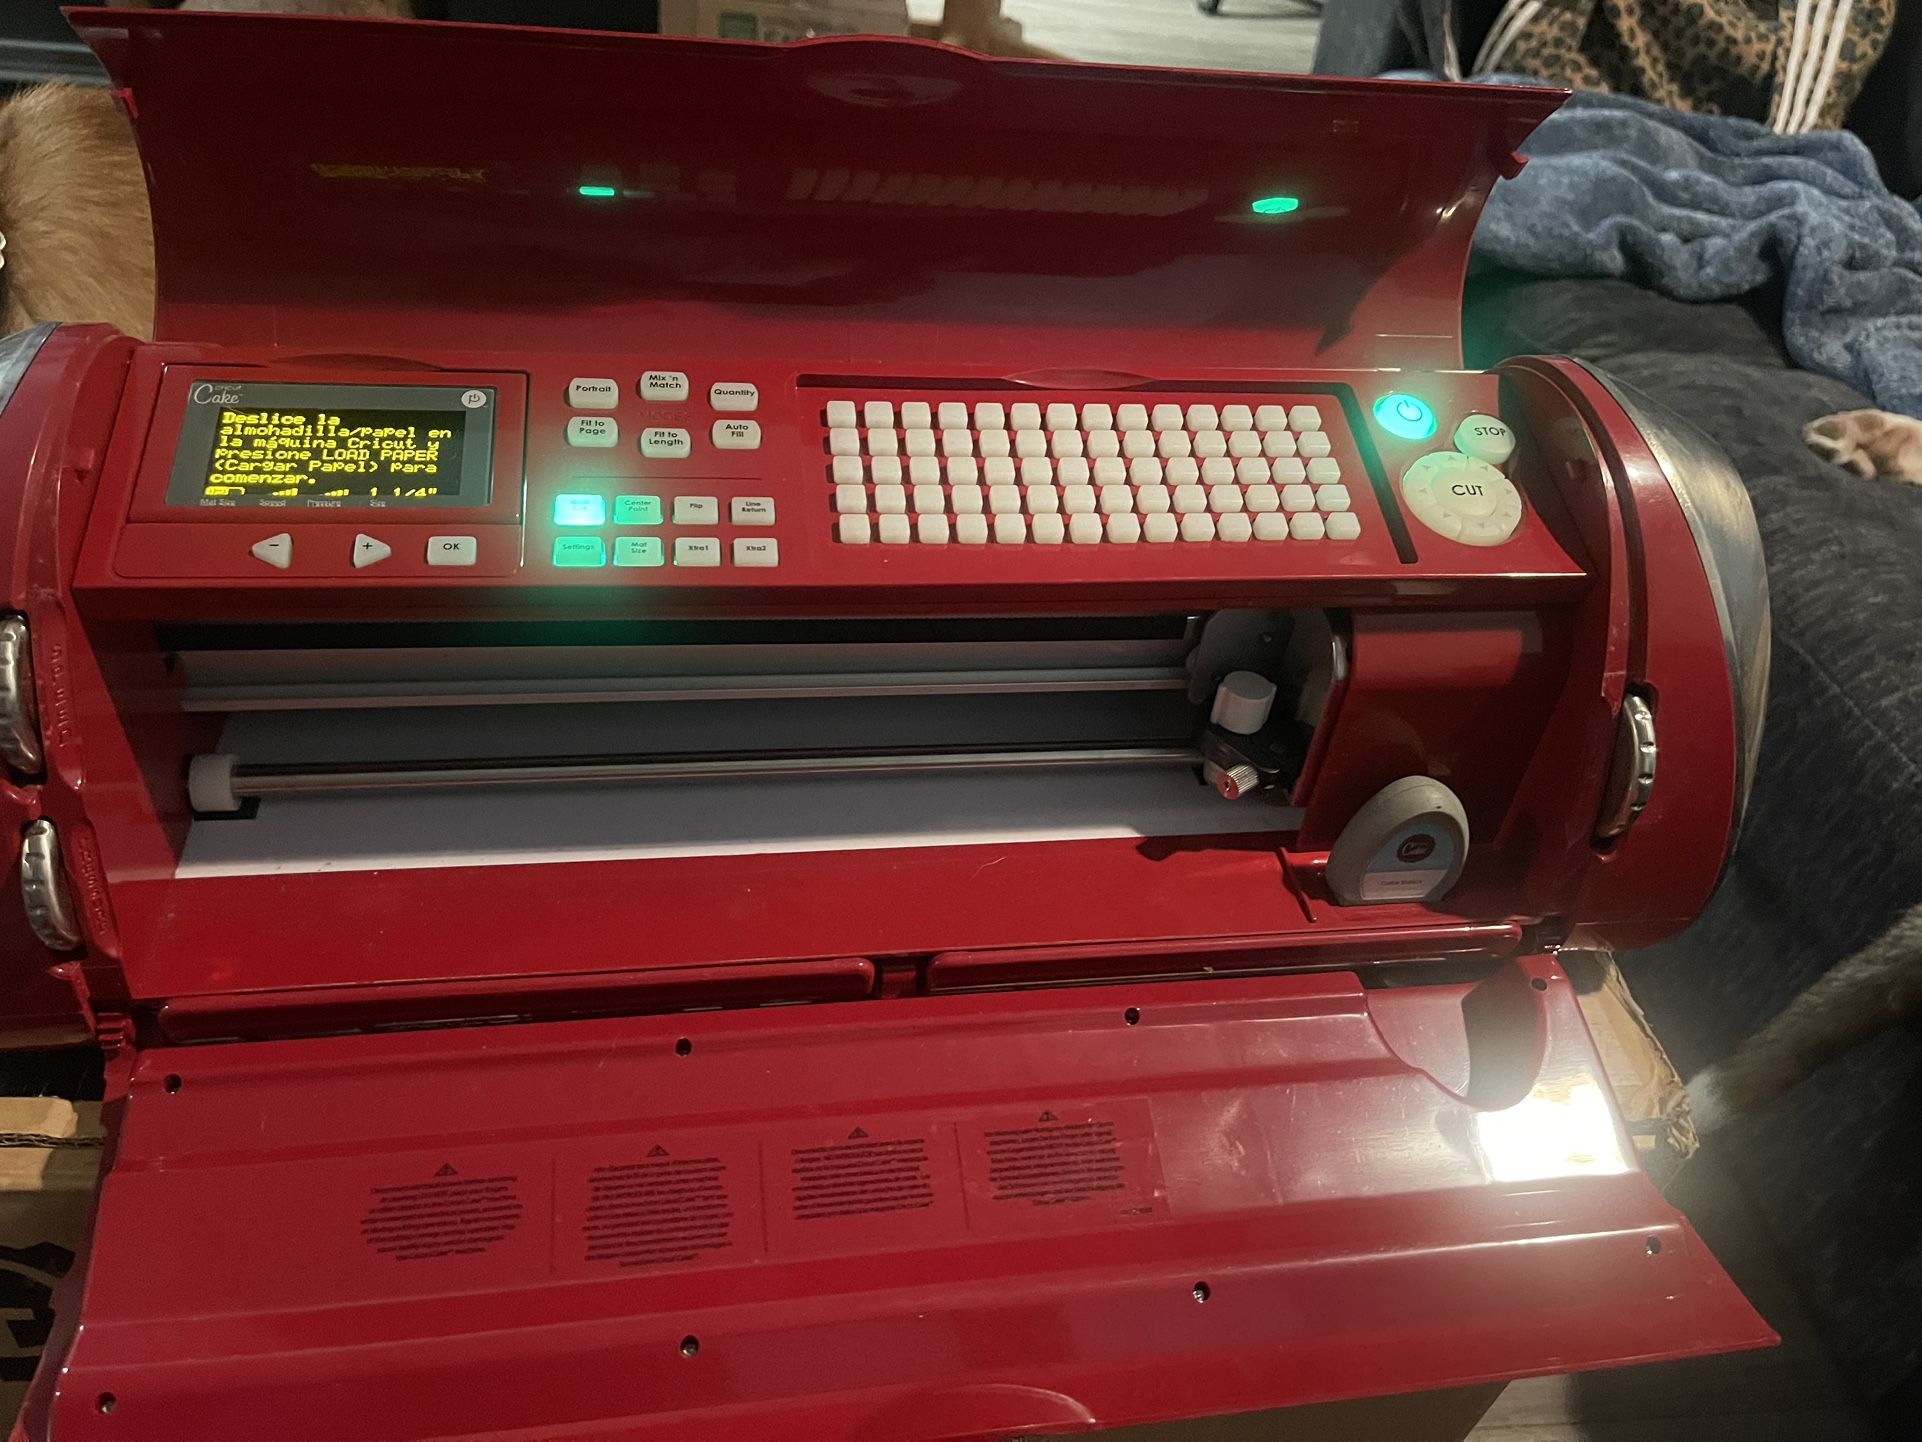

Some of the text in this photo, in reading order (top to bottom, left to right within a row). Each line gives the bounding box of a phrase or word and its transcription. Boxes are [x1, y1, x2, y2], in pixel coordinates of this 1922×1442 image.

[194, 384, 240, 405] Cake
[714, 389, 755, 397] Quantity
[222, 412, 340, 425] Deslice la
[220, 426, 452, 438] almohadilla/papel en
[579, 427, 606, 435] Page
[1474, 427, 1506, 436] STOP
[220, 437, 440, 451] la máquina Cricut y
[649, 438, 683, 446] Length
[215, 449, 438, 461] presione LOAD PAPER
[391, 462, 437, 473] para
[209, 473, 316, 484] comenzar.
[370, 487, 437, 497] 1 1/4"
[1451, 485, 1483, 496] CUT
[443, 542, 460, 551] OK
